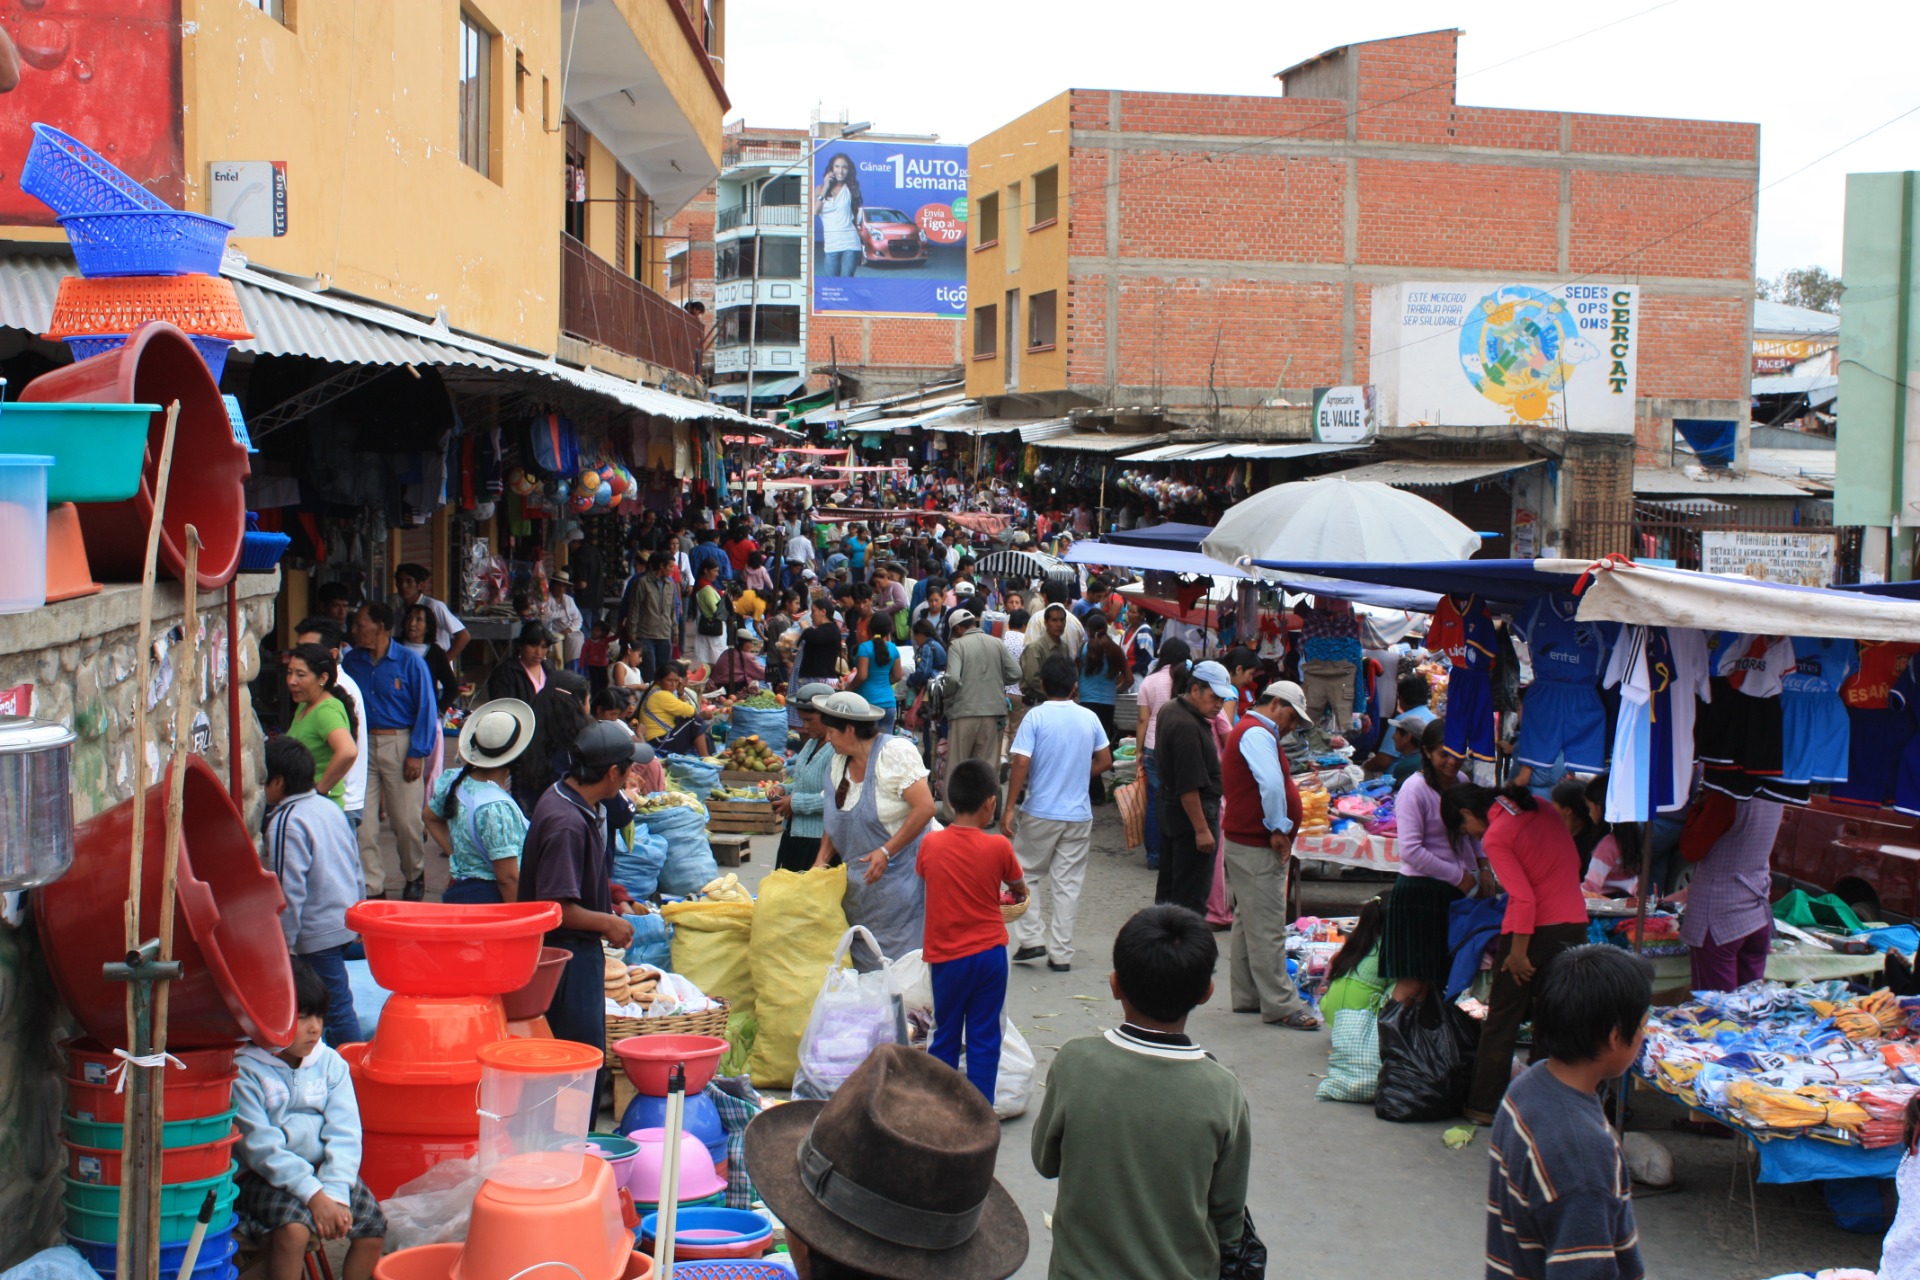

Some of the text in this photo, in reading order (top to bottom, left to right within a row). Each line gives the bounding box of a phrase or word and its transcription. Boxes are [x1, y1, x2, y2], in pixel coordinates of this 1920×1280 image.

[214, 171, 239, 182] Entel
[860, 161, 891, 173] Gánate
[886, 153, 904, 189] 1
[906, 159, 959, 177] AUTO
[905, 177, 967, 191] semana
[921, 217, 955, 231] Tigo al
[941, 230, 962, 240] 707
[936, 286, 968, 303] tigo
[1408, 292, 1467, 304] ESTE MERCADO
[1565, 286, 1609, 299] SEDES
[1406, 304, 1463, 315] TRABAJA PARA
[1577, 303, 1608, 314] OPS
[1402, 315, 1465, 326] SER SALUDABLE
[1579, 317, 1609, 330] OMS
[1609, 290, 1632, 395] CERCAT
[1757, 358, 1791, 369] PACEÑA
[1326, 394, 1355, 407] Agropecuaria
[1550, 652, 1580, 664] entel
[1796, 662, 1818, 673] ntel
